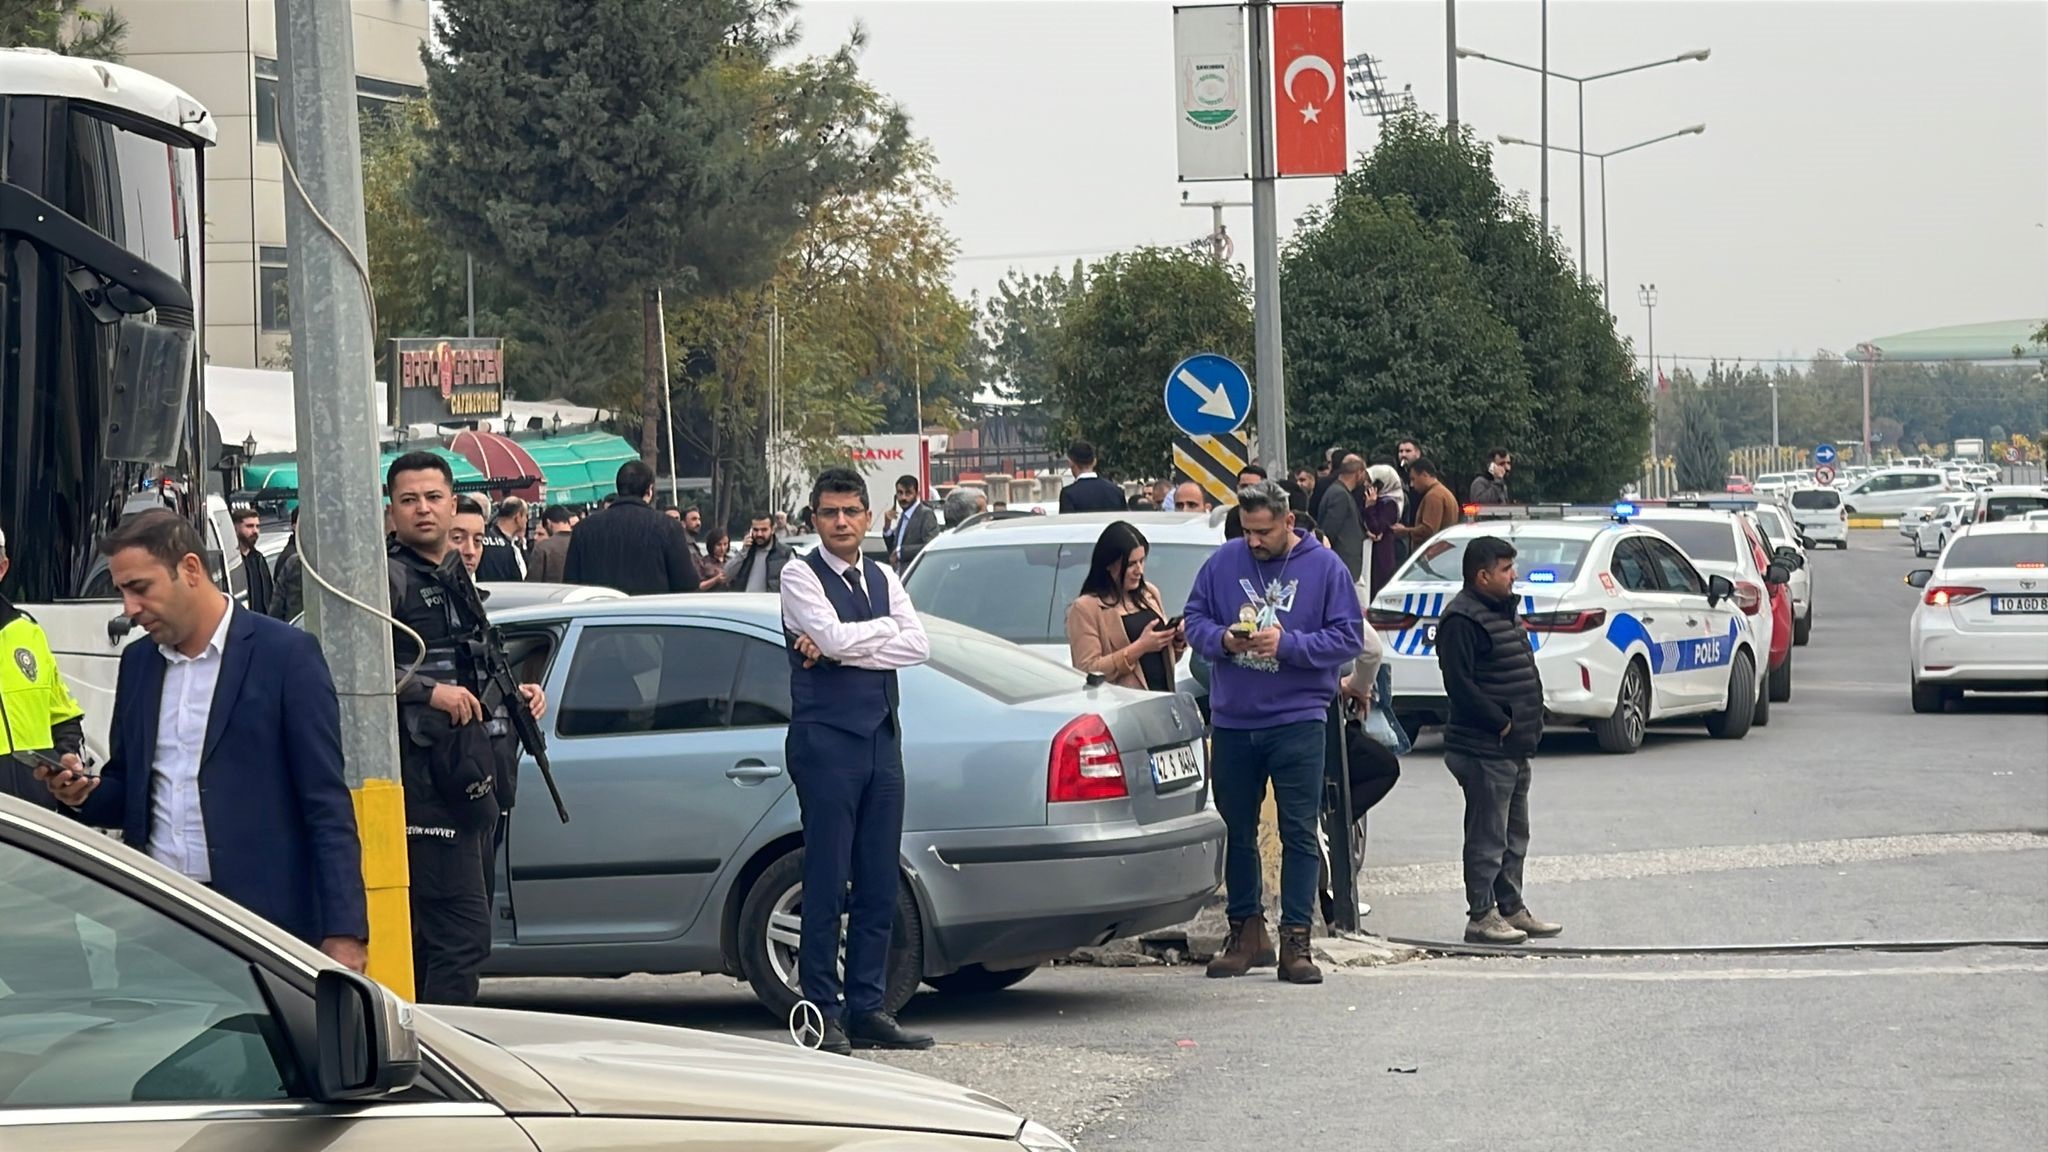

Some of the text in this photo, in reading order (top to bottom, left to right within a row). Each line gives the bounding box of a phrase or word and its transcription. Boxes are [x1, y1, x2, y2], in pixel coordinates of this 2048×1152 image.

[404, 351, 440, 387] BARO
[2000, 598, 2014, 610] 10
[2016, 598, 2039, 610] AGD
[1427, 626, 1437, 640] 6
[1695, 638, 1720, 664] POLİS
[1156, 755, 1168, 780] 42
[1169, 753, 1176, 777] S
